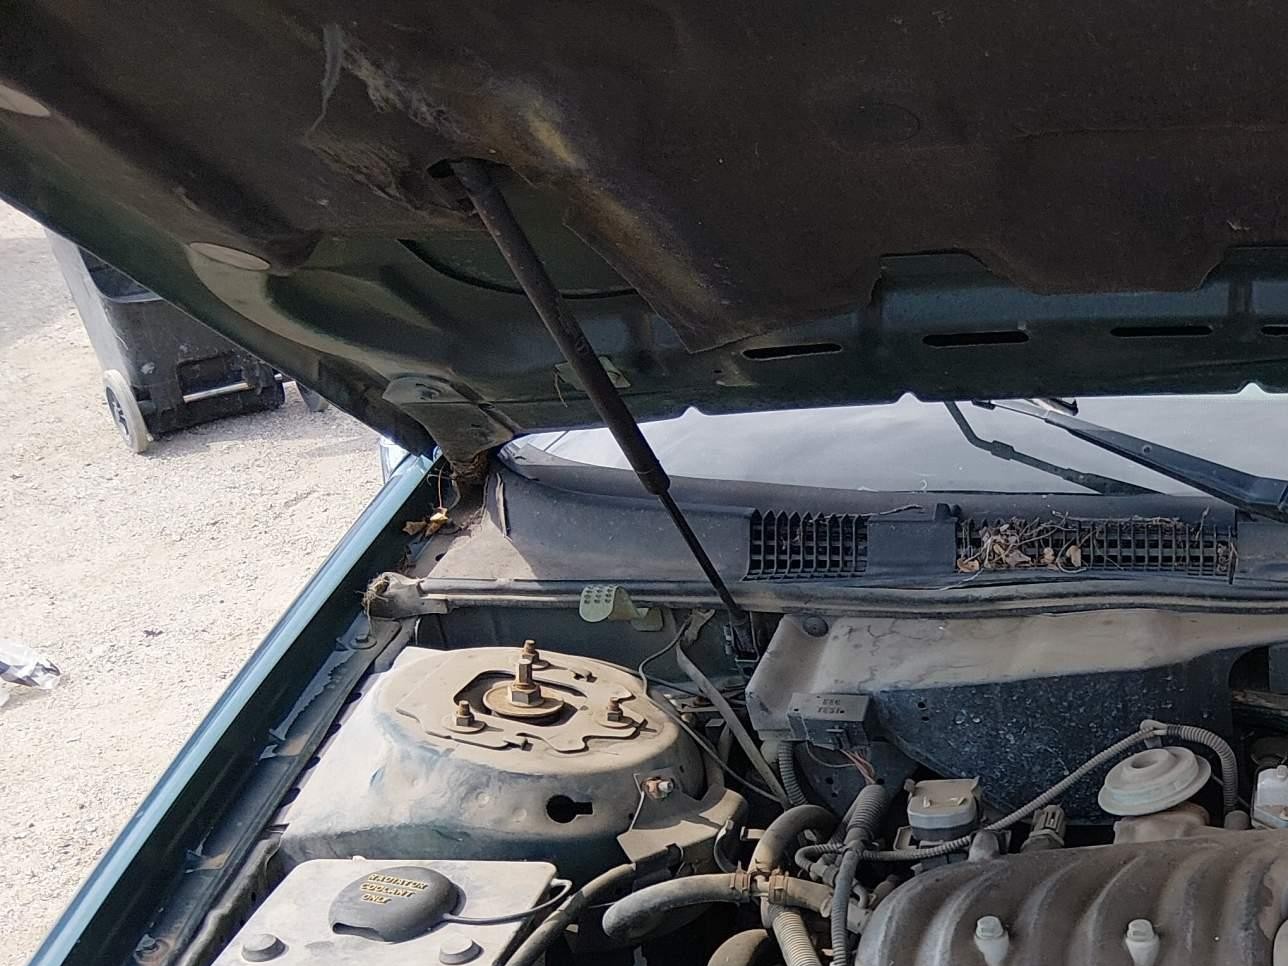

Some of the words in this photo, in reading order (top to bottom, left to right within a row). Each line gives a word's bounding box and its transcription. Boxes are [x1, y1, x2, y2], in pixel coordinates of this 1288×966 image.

[368, 874, 428, 890] RADIATOR
[361, 883, 416, 898] COOLANT
[361, 893, 392, 904] ONLY
